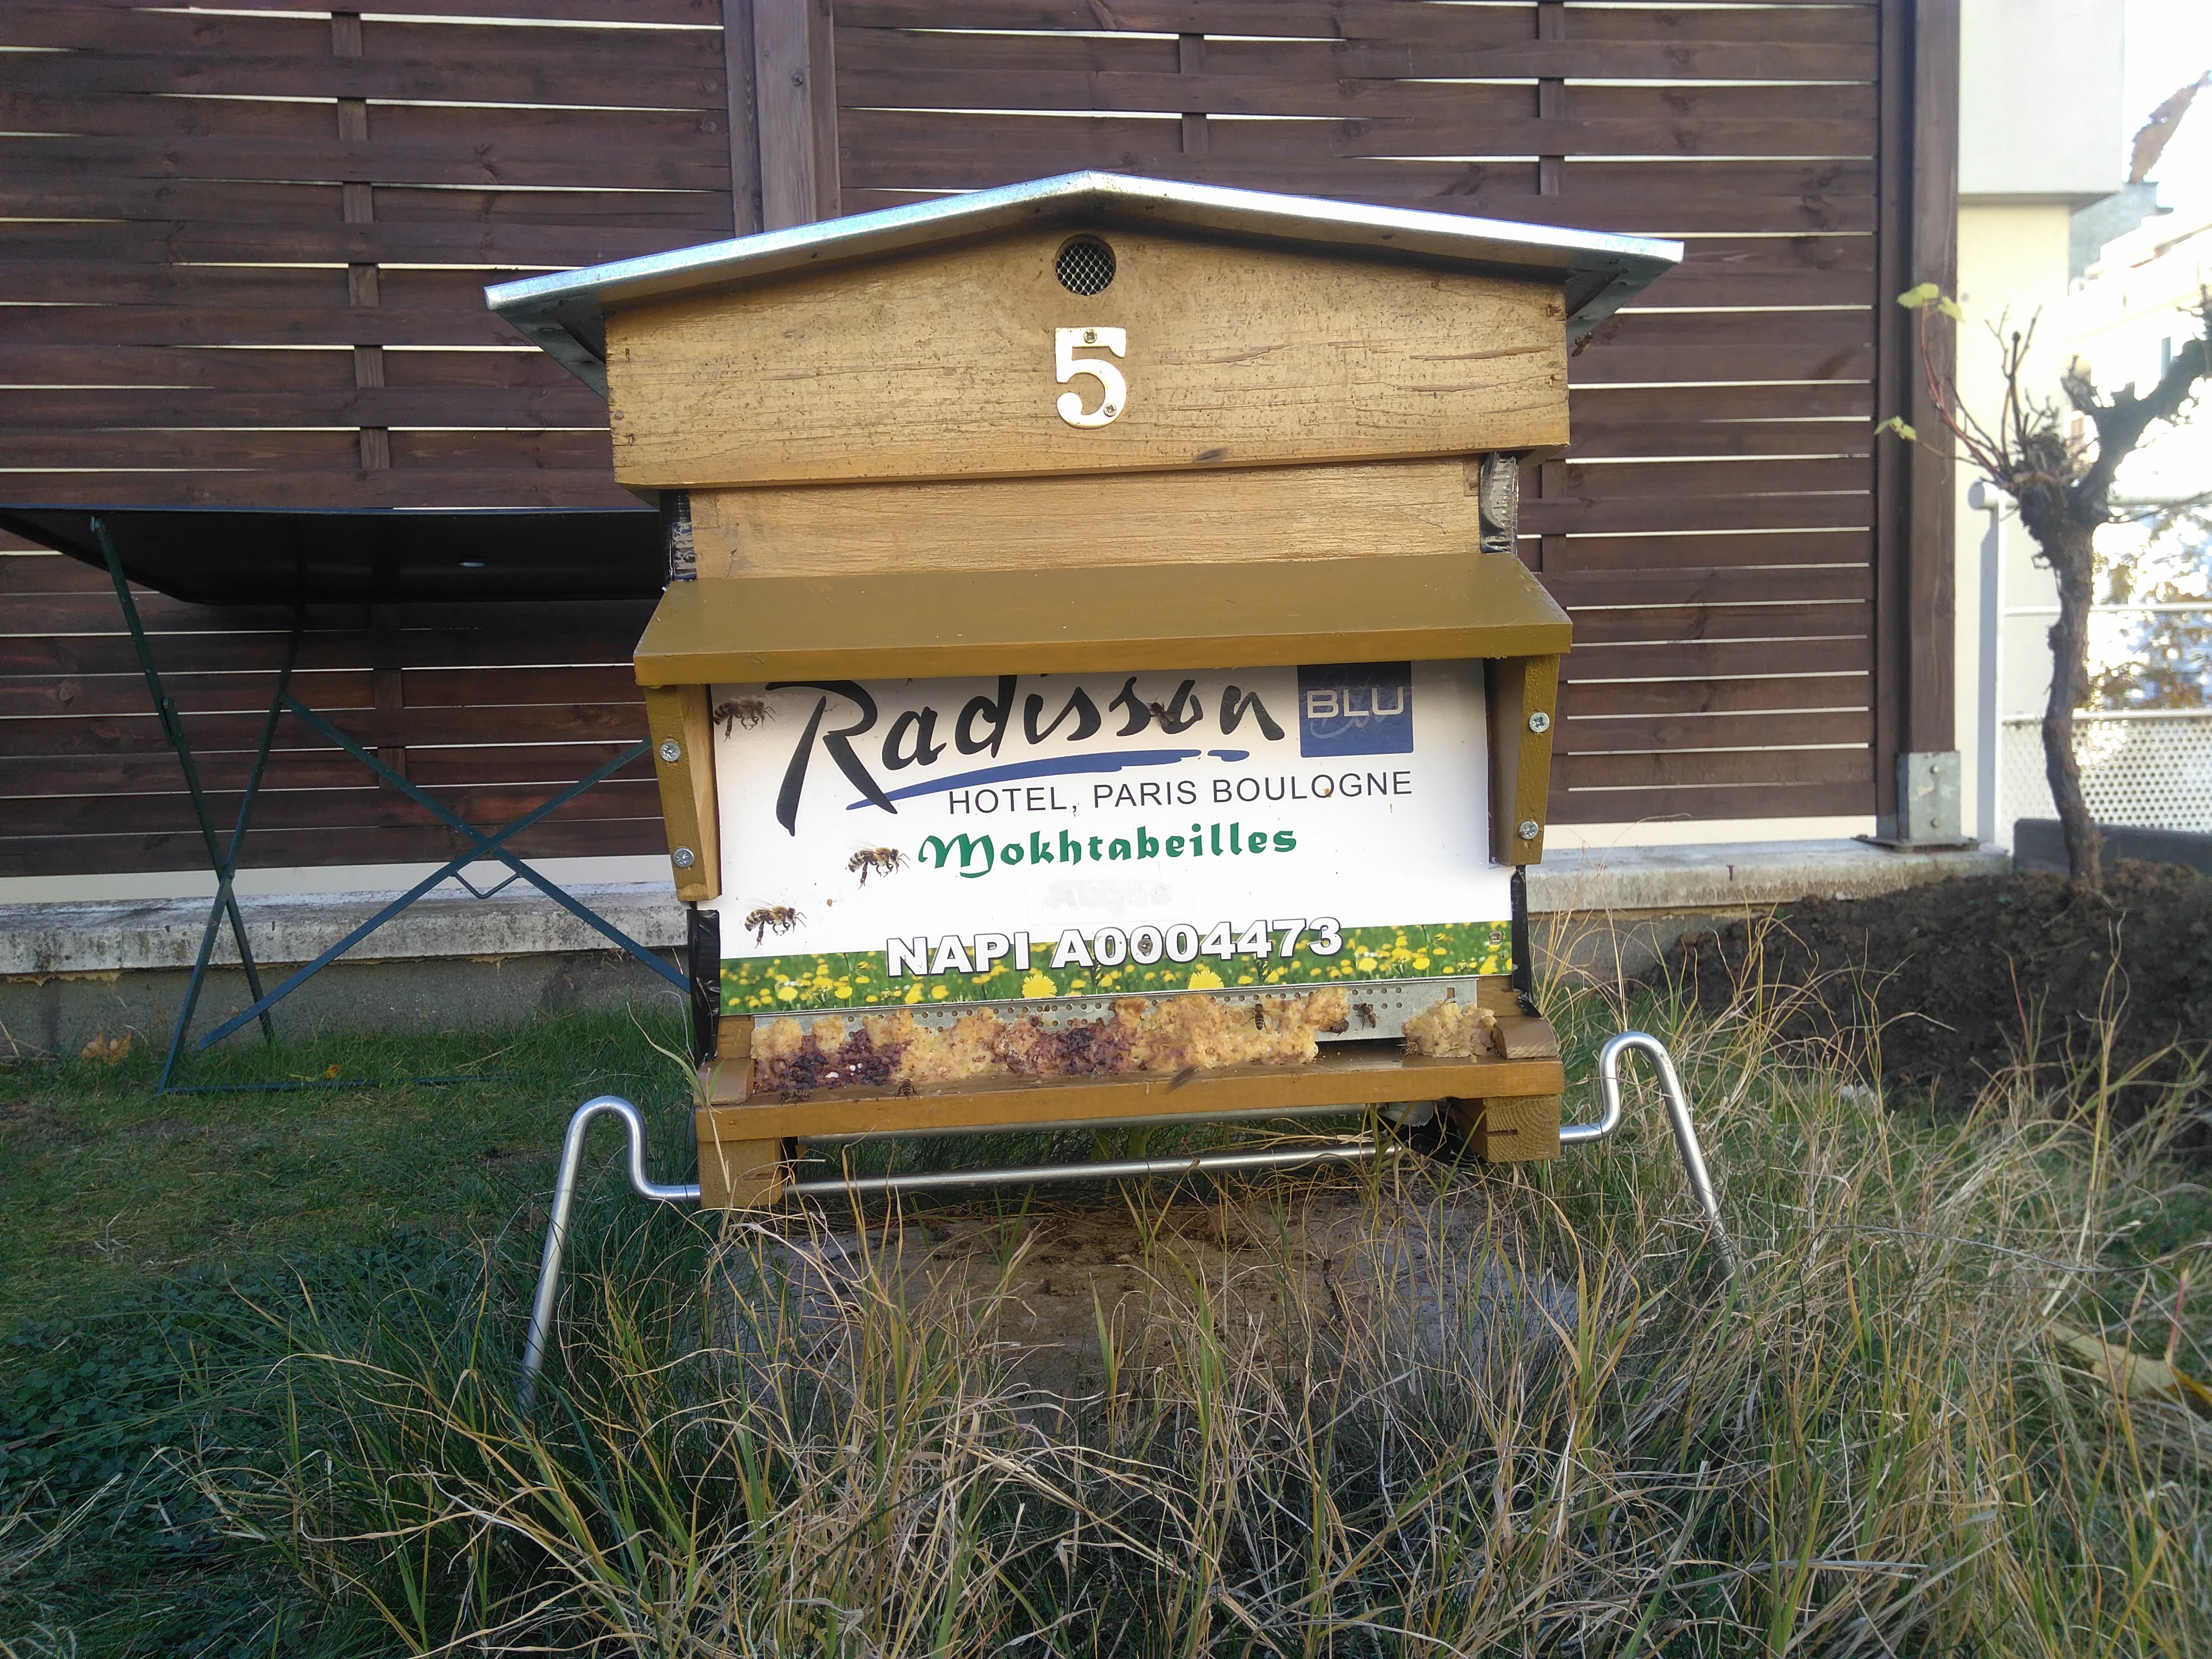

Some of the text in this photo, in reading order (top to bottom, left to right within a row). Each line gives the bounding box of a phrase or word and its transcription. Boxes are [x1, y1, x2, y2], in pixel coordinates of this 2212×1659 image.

[1055, 327, 1126, 429] 5
[763, 672, 1285, 836] Radisson
[1307, 687, 1403, 718] BLU
[1094, 781, 1197, 808] PARIS
[1213, 771, 1412, 803] BOULOGNE
[918, 822, 1297, 878] Mokhtabeilles
[886, 917, 1342, 977] NAPI A0004473
